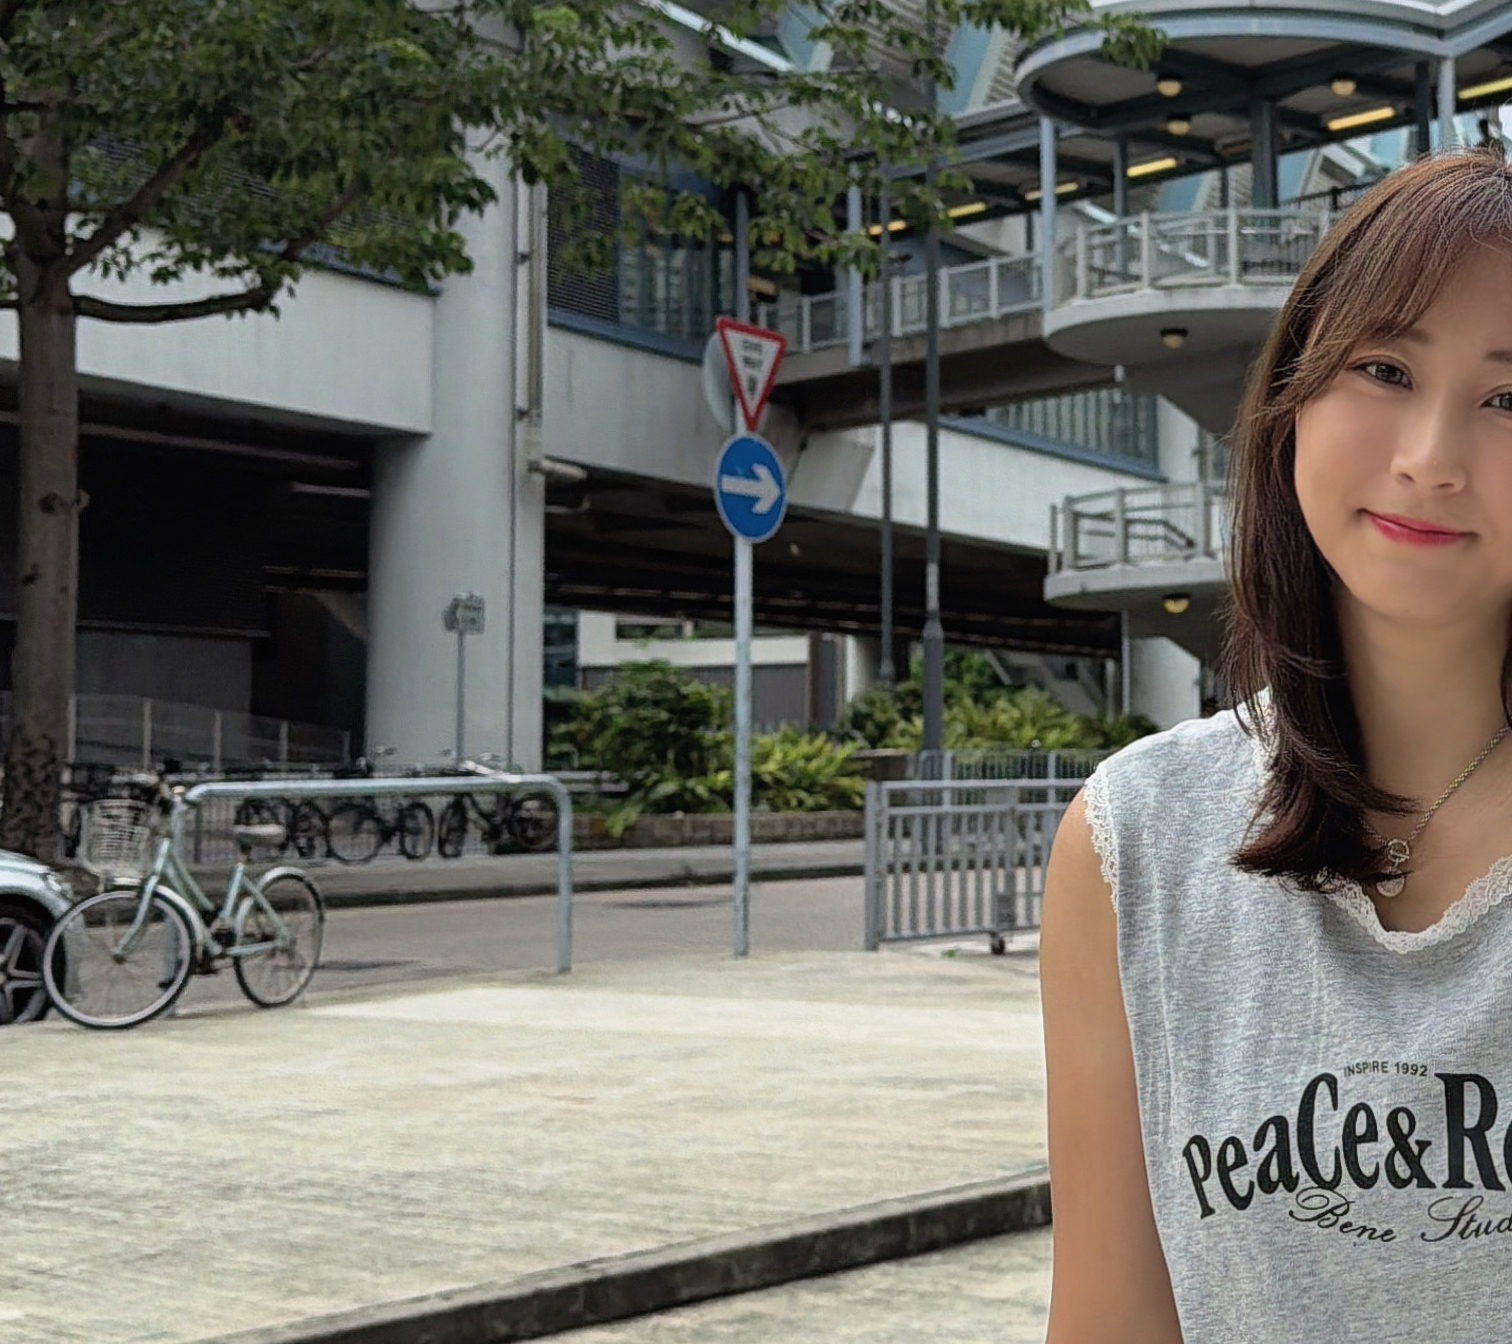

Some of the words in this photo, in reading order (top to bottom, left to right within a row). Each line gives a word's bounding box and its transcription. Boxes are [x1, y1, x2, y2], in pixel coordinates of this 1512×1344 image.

[1343, 1060, 1389, 1077] INSPIRE
[1394, 1061, 1428, 1077] 1992
[1288, 1186, 1397, 1243] Bene
